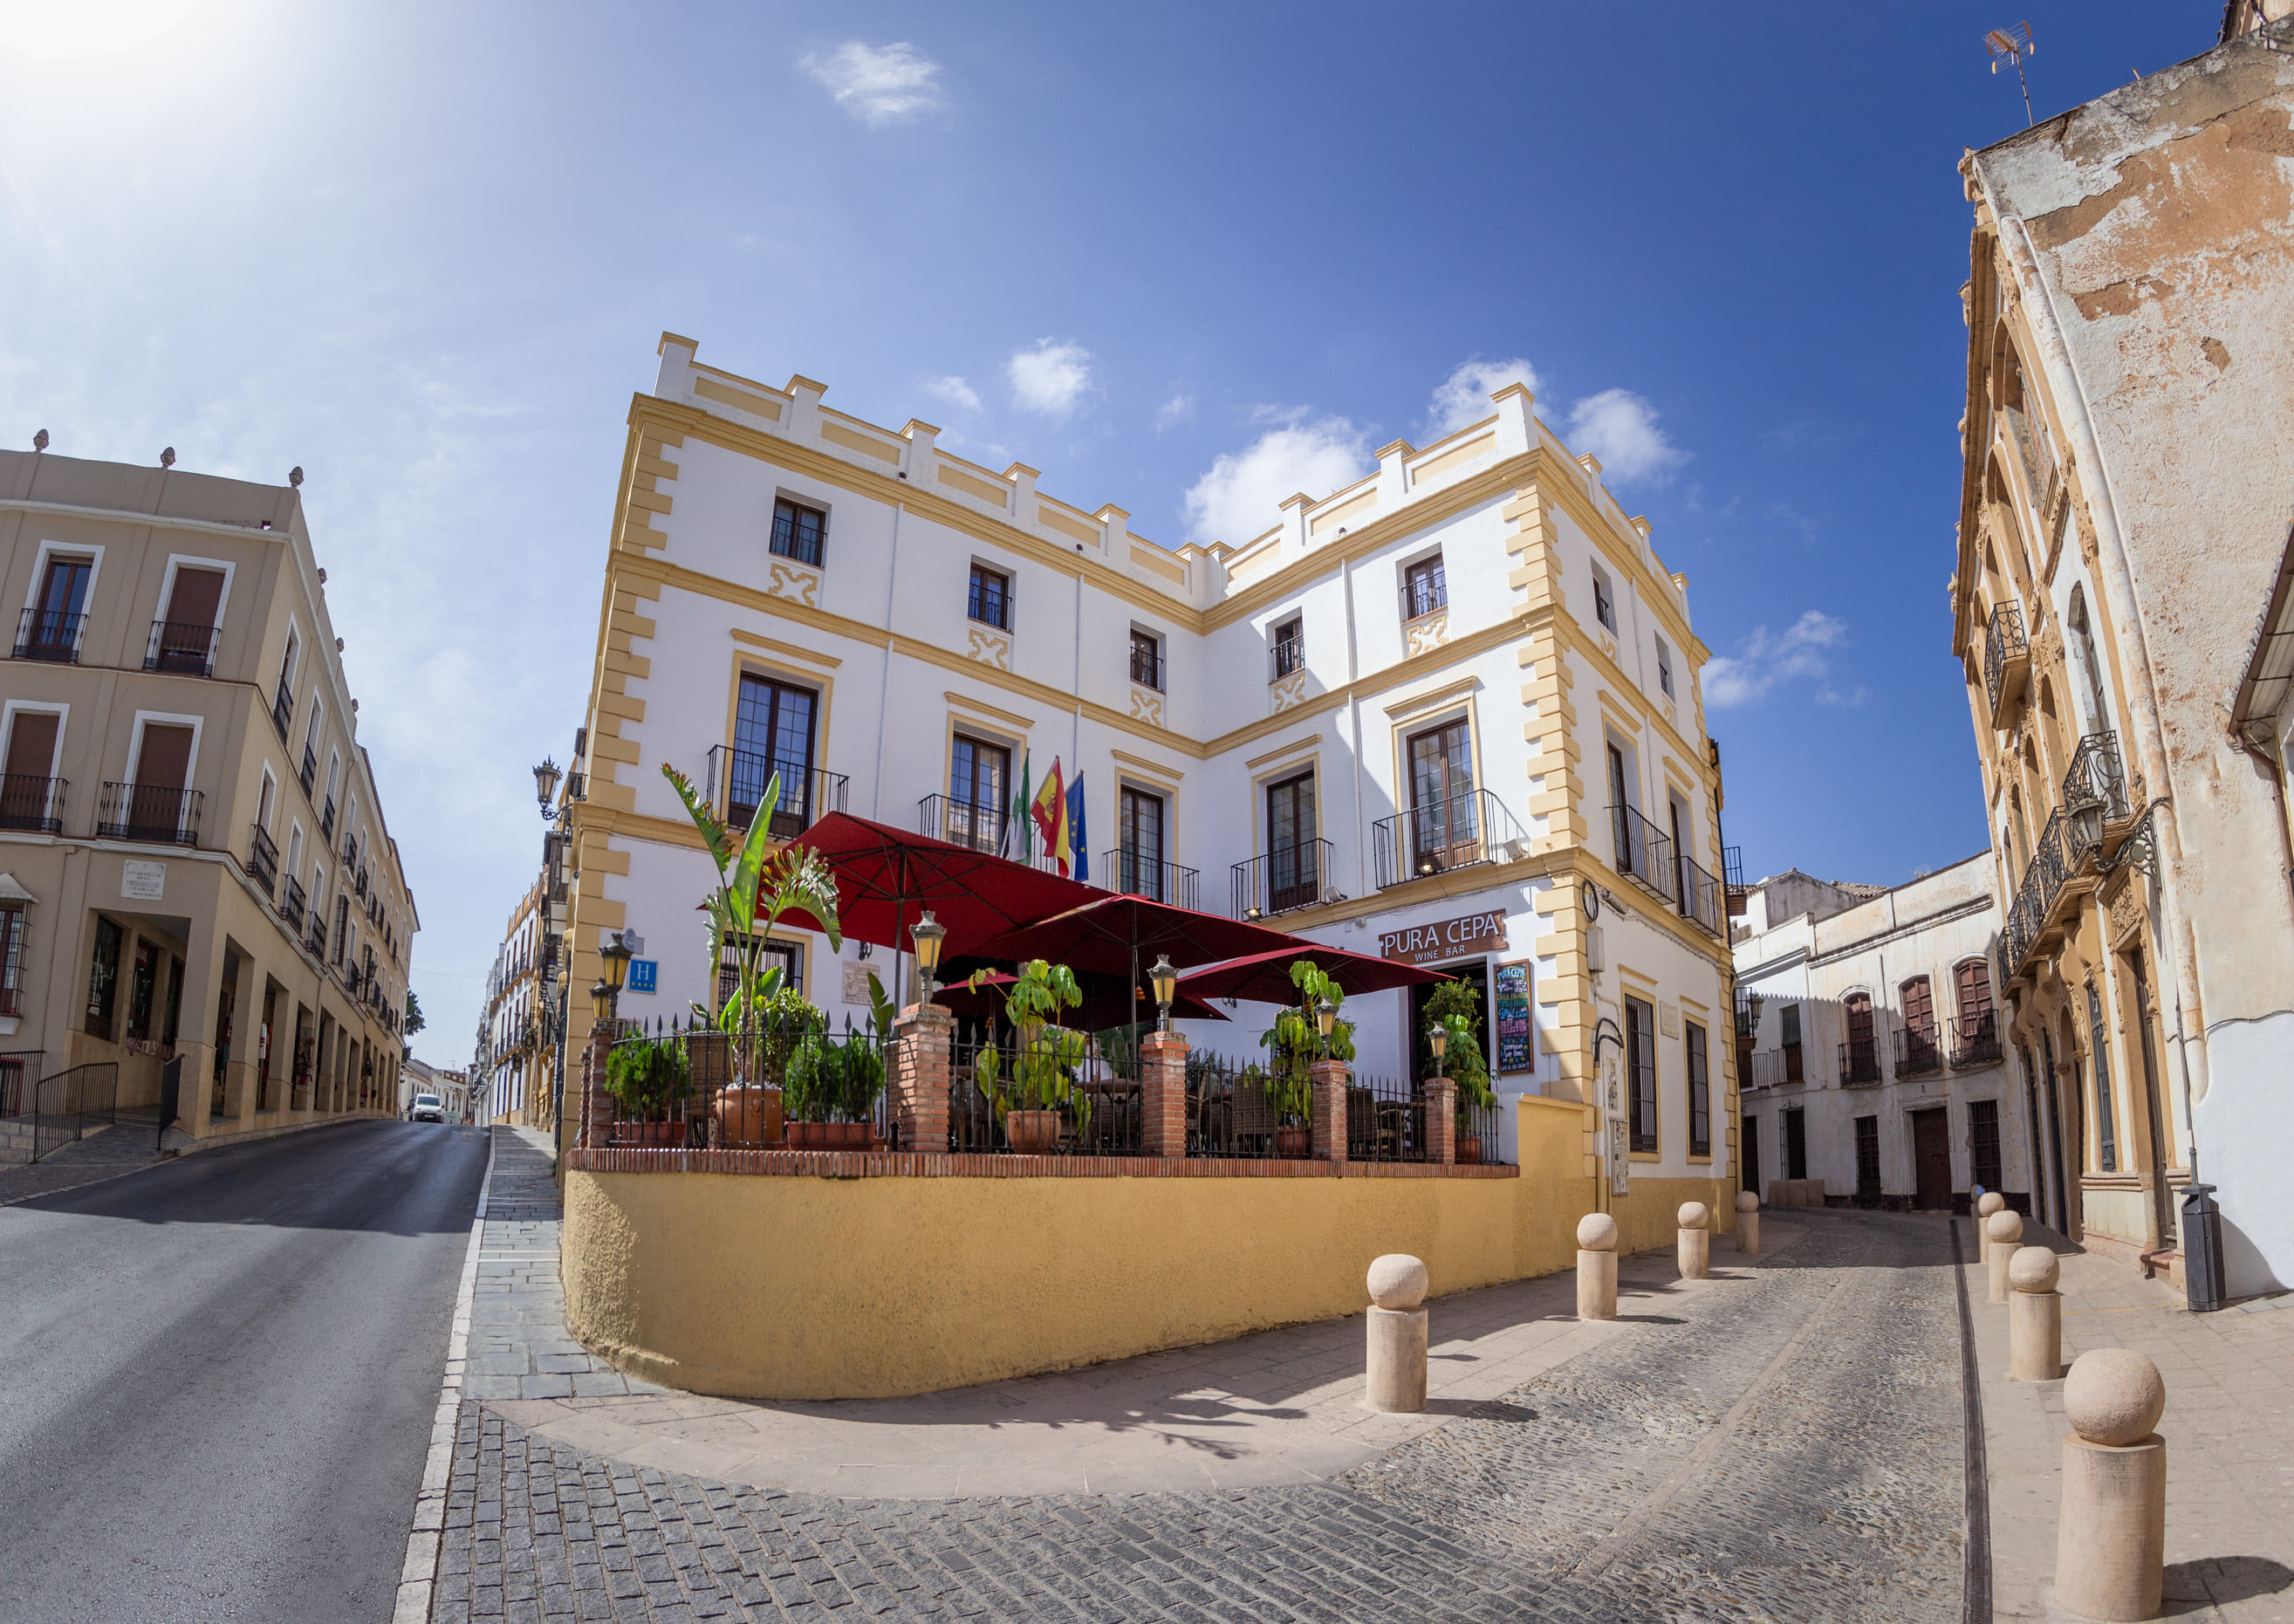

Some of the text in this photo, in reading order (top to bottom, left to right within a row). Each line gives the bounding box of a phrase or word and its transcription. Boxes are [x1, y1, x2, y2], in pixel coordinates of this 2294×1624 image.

[1385, 914, 1499, 956] PURA CEPA
[1414, 944, 1466, 963] WINE BAR
[636, 963, 649, 981] H
[1497, 969, 1525, 980] PURA CEPA
